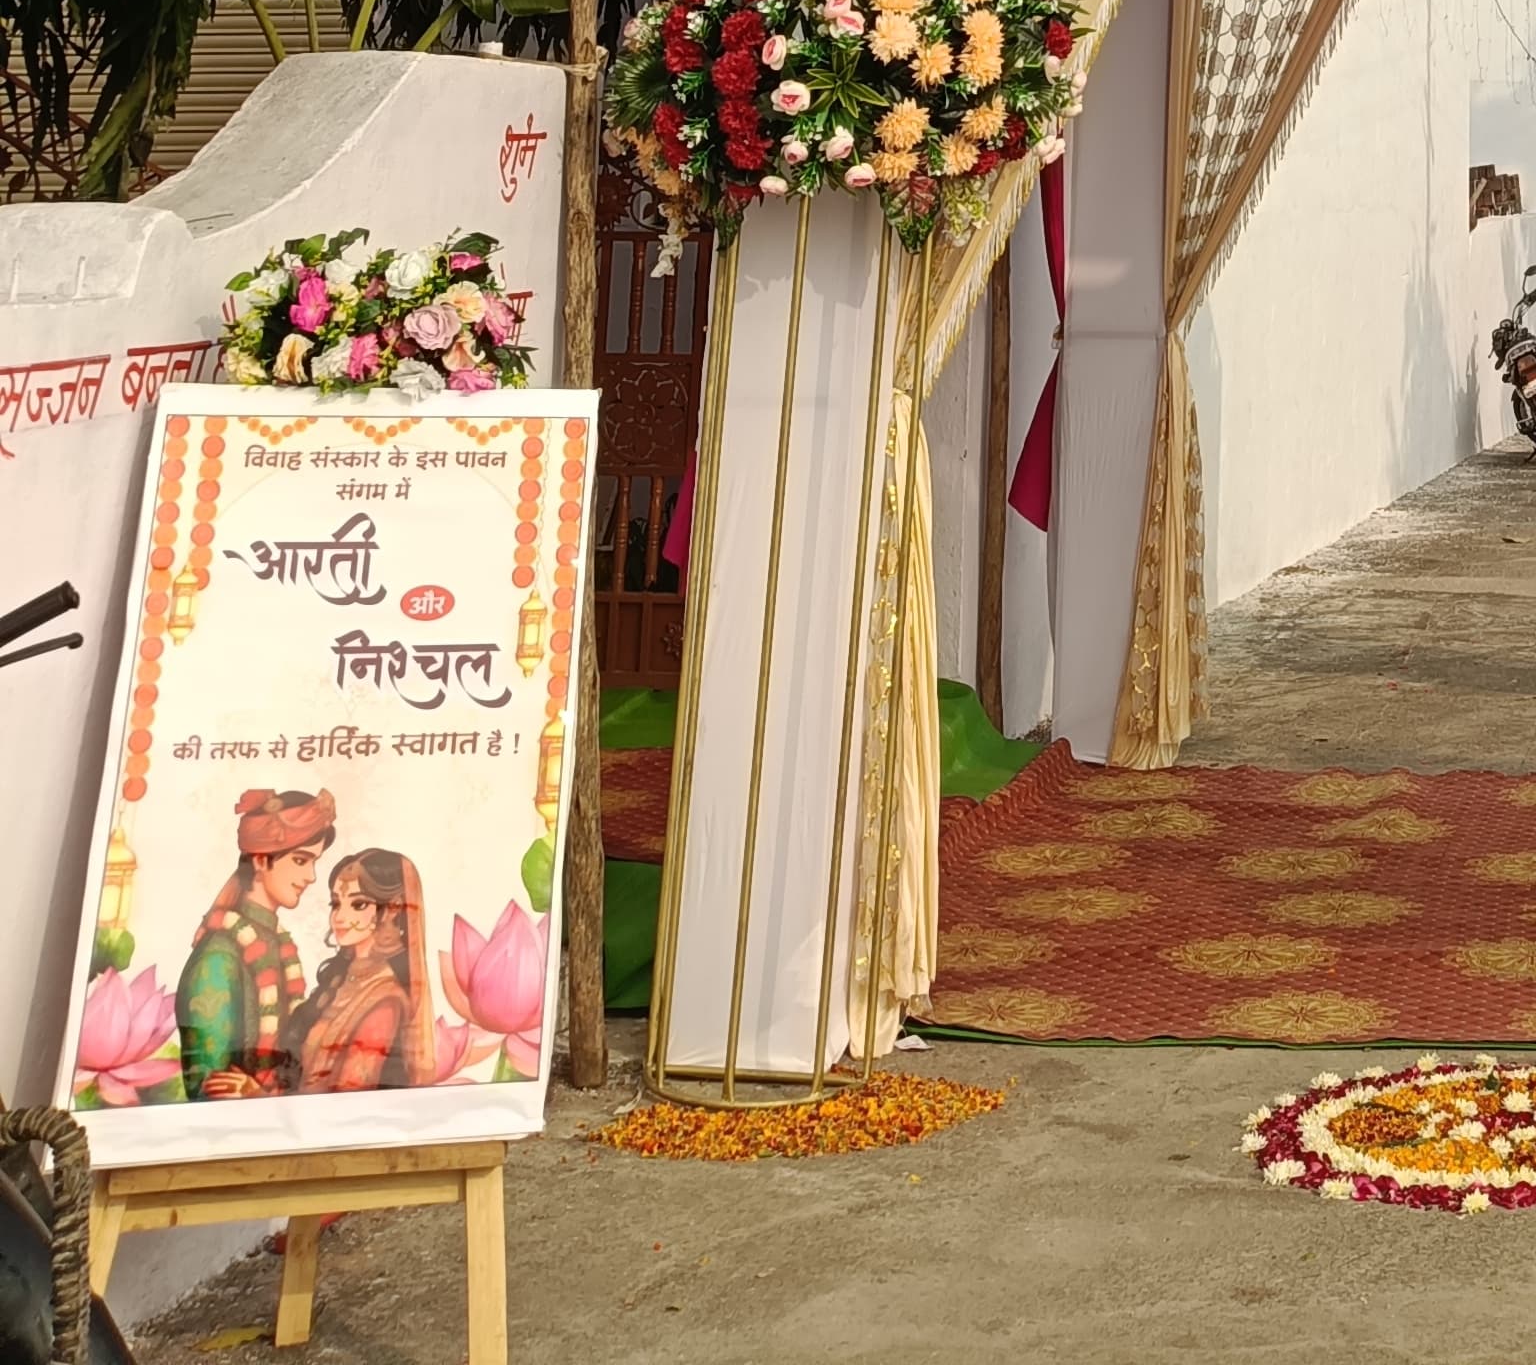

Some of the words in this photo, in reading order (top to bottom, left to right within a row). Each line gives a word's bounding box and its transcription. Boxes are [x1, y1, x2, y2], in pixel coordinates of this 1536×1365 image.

[244, 444, 303, 471] विवाह
[309, 446, 381, 468] संस्कार
[387, 444, 409, 468] के
[415, 451, 449, 471] इस
[455, 451, 508, 468] पावन
[335, 478, 388, 501] संगम
[395, 476, 412, 500] में
[222, 512, 388, 606] आरती
[409, 591, 446, 615] और
[330, 629, 513, 711] निश्चल
[173, 734, 202, 760] की
[210, 741, 260, 760] तरफ
[268, 733, 289, 759] से
[296, 725, 383, 763] हार्दिक
[391, 731, 481, 757] स्वागत
[487, 729, 503, 757] है
